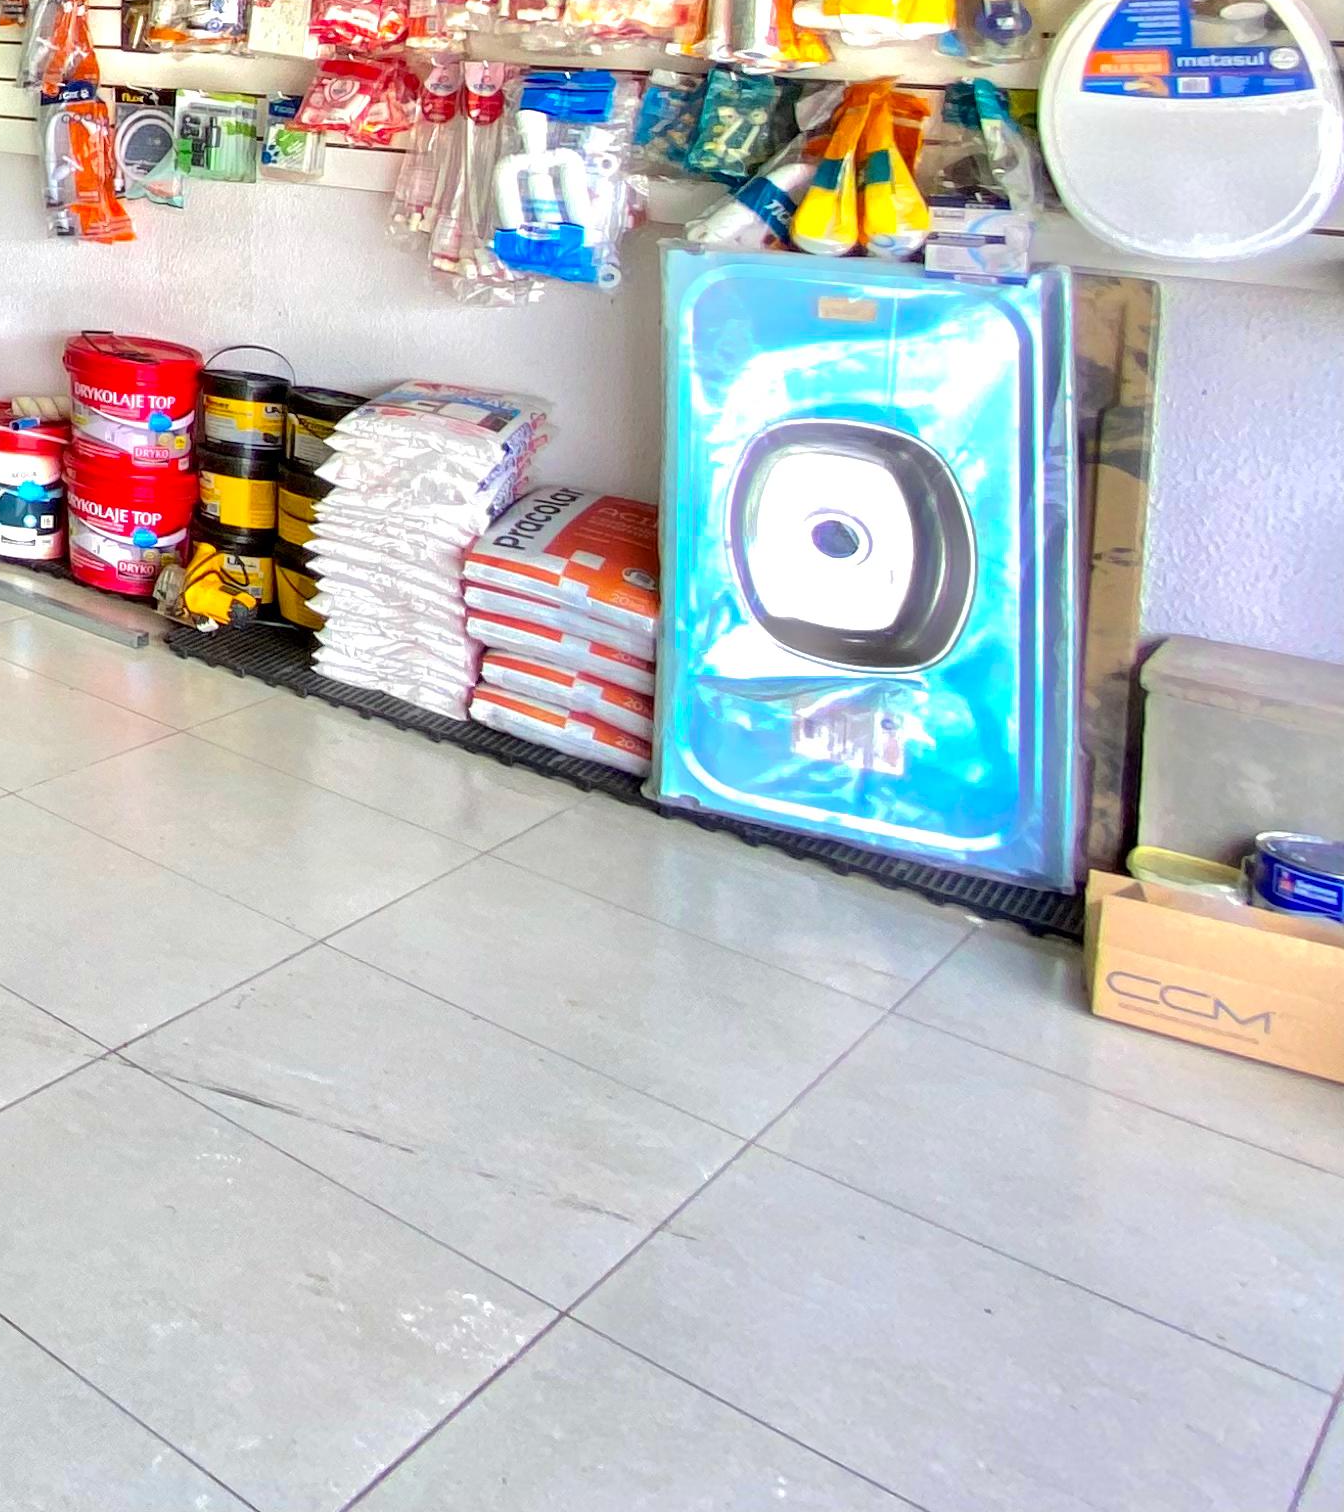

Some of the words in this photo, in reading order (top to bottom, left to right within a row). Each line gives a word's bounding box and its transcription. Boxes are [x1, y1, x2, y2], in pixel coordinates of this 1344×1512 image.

[1176, 51, 1265, 68] metasul
[74, 381, 145, 409] DRYKOLAJE
[148, 395, 177, 409] TOP
[134, 447, 169, 459] DRYKO
[131, 510, 163, 527] TOP
[118, 561, 154, 575] DRYKO
[1106, 970, 1277, 1034] CCM
